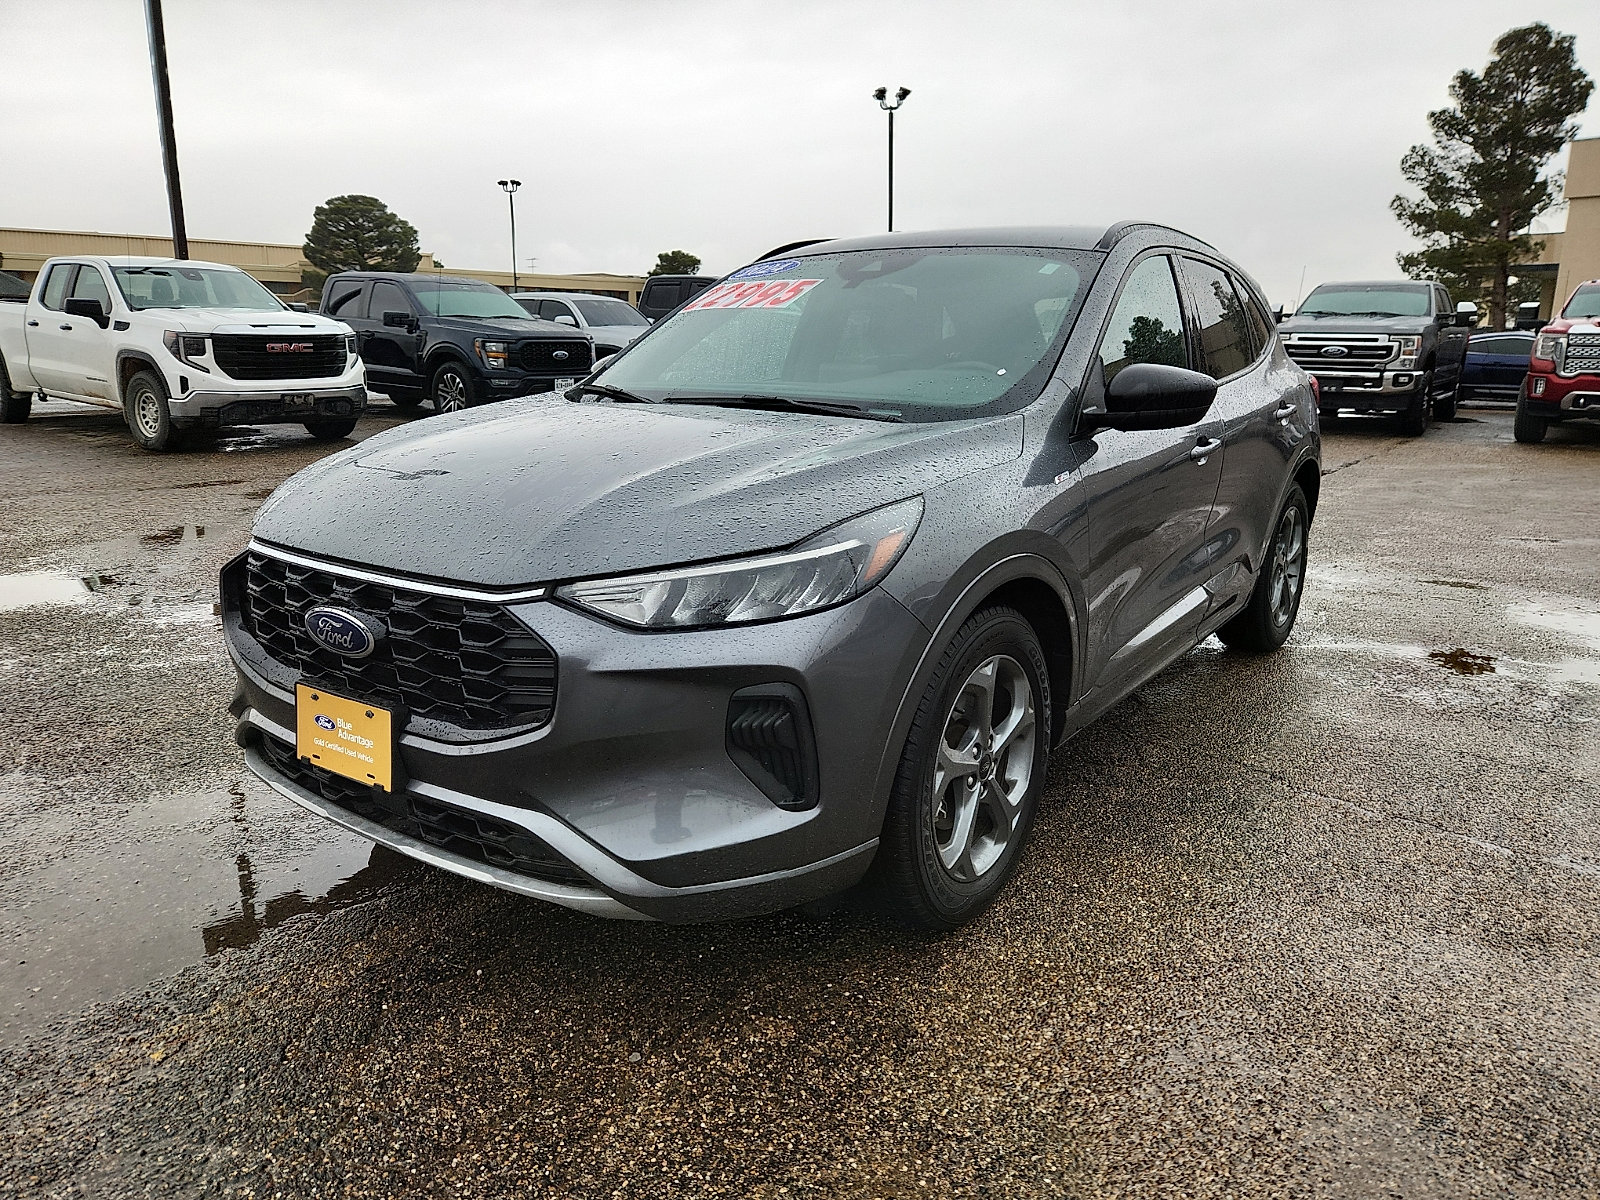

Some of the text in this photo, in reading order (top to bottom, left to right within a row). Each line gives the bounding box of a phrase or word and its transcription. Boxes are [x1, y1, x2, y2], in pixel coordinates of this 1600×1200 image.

[266, 342, 314, 353] GMC
[317, 616, 354, 650] Ford
[336, 718, 353, 731] Blue
[337, 729, 374, 749] Advantage
[313, 737, 374, 763] Gold Certified Used Vehicle
